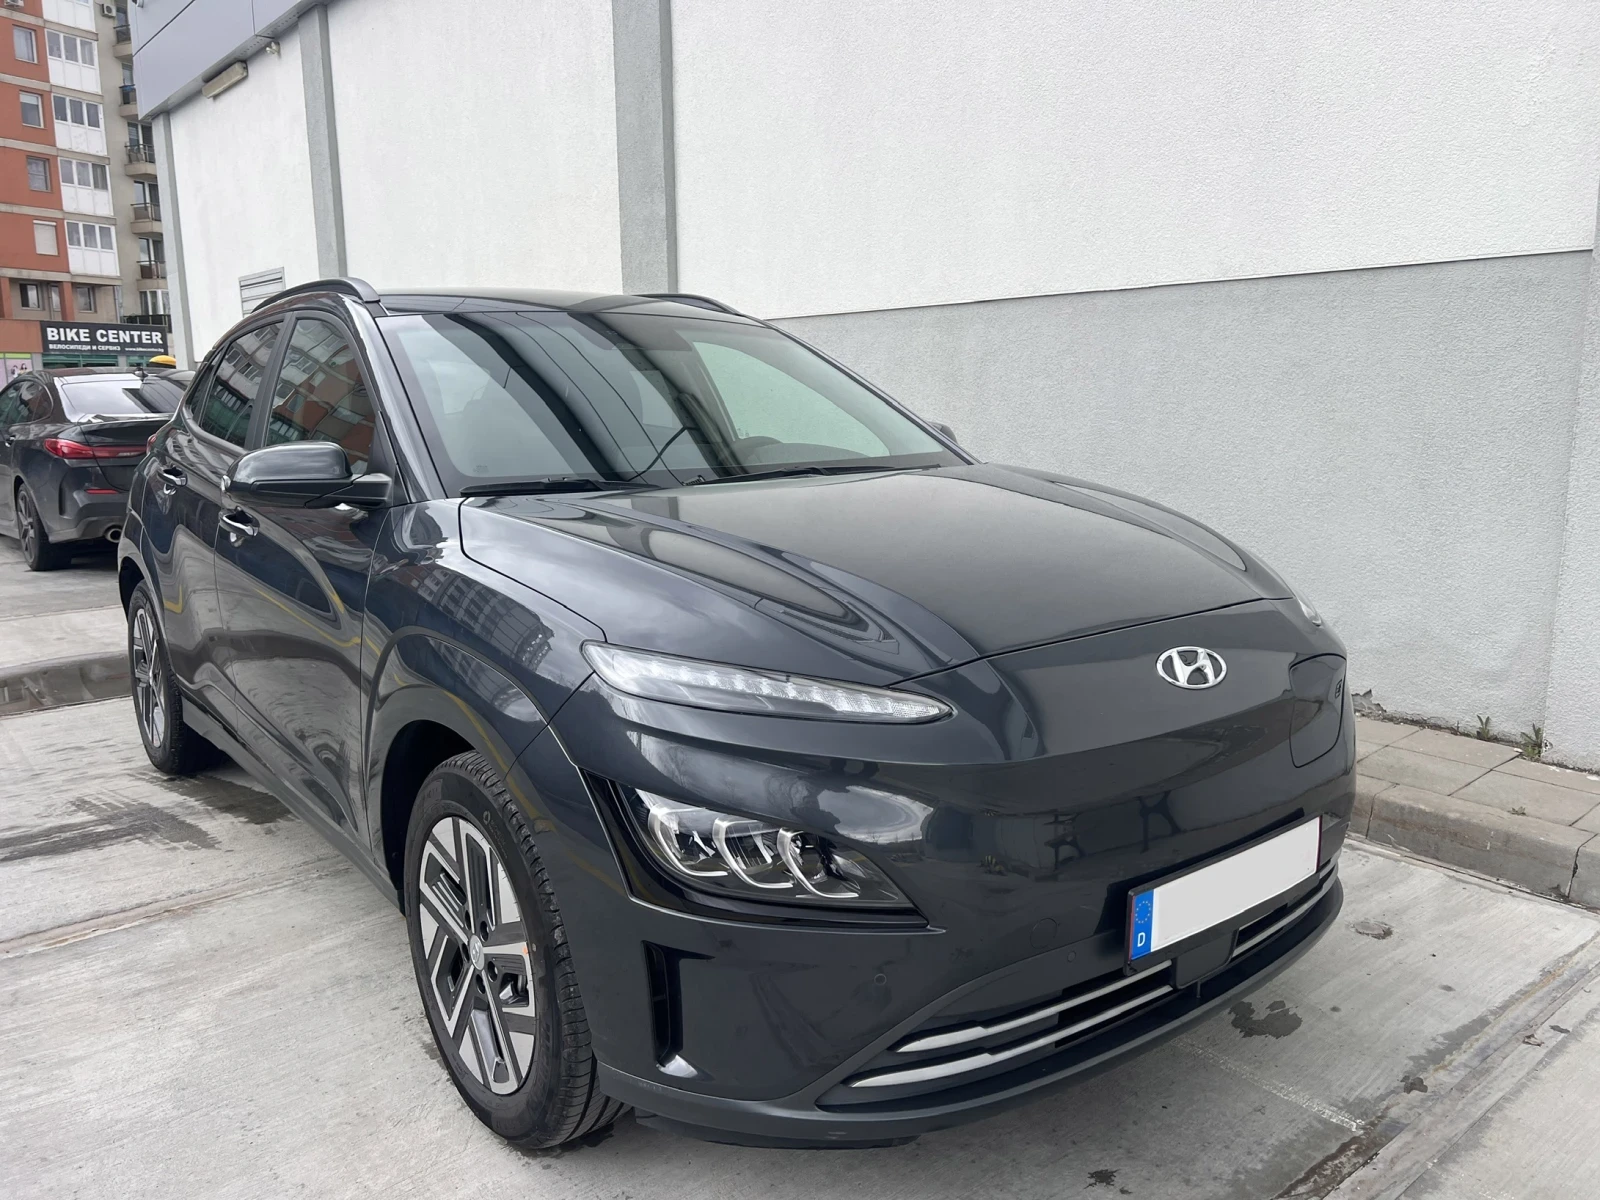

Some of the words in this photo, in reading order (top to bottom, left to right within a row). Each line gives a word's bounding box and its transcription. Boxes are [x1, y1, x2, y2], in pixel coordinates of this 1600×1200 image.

[46, 327, 91, 342] BIKE
[95, 329, 164, 344] CENTER
[1137, 932, 1146, 947] D
